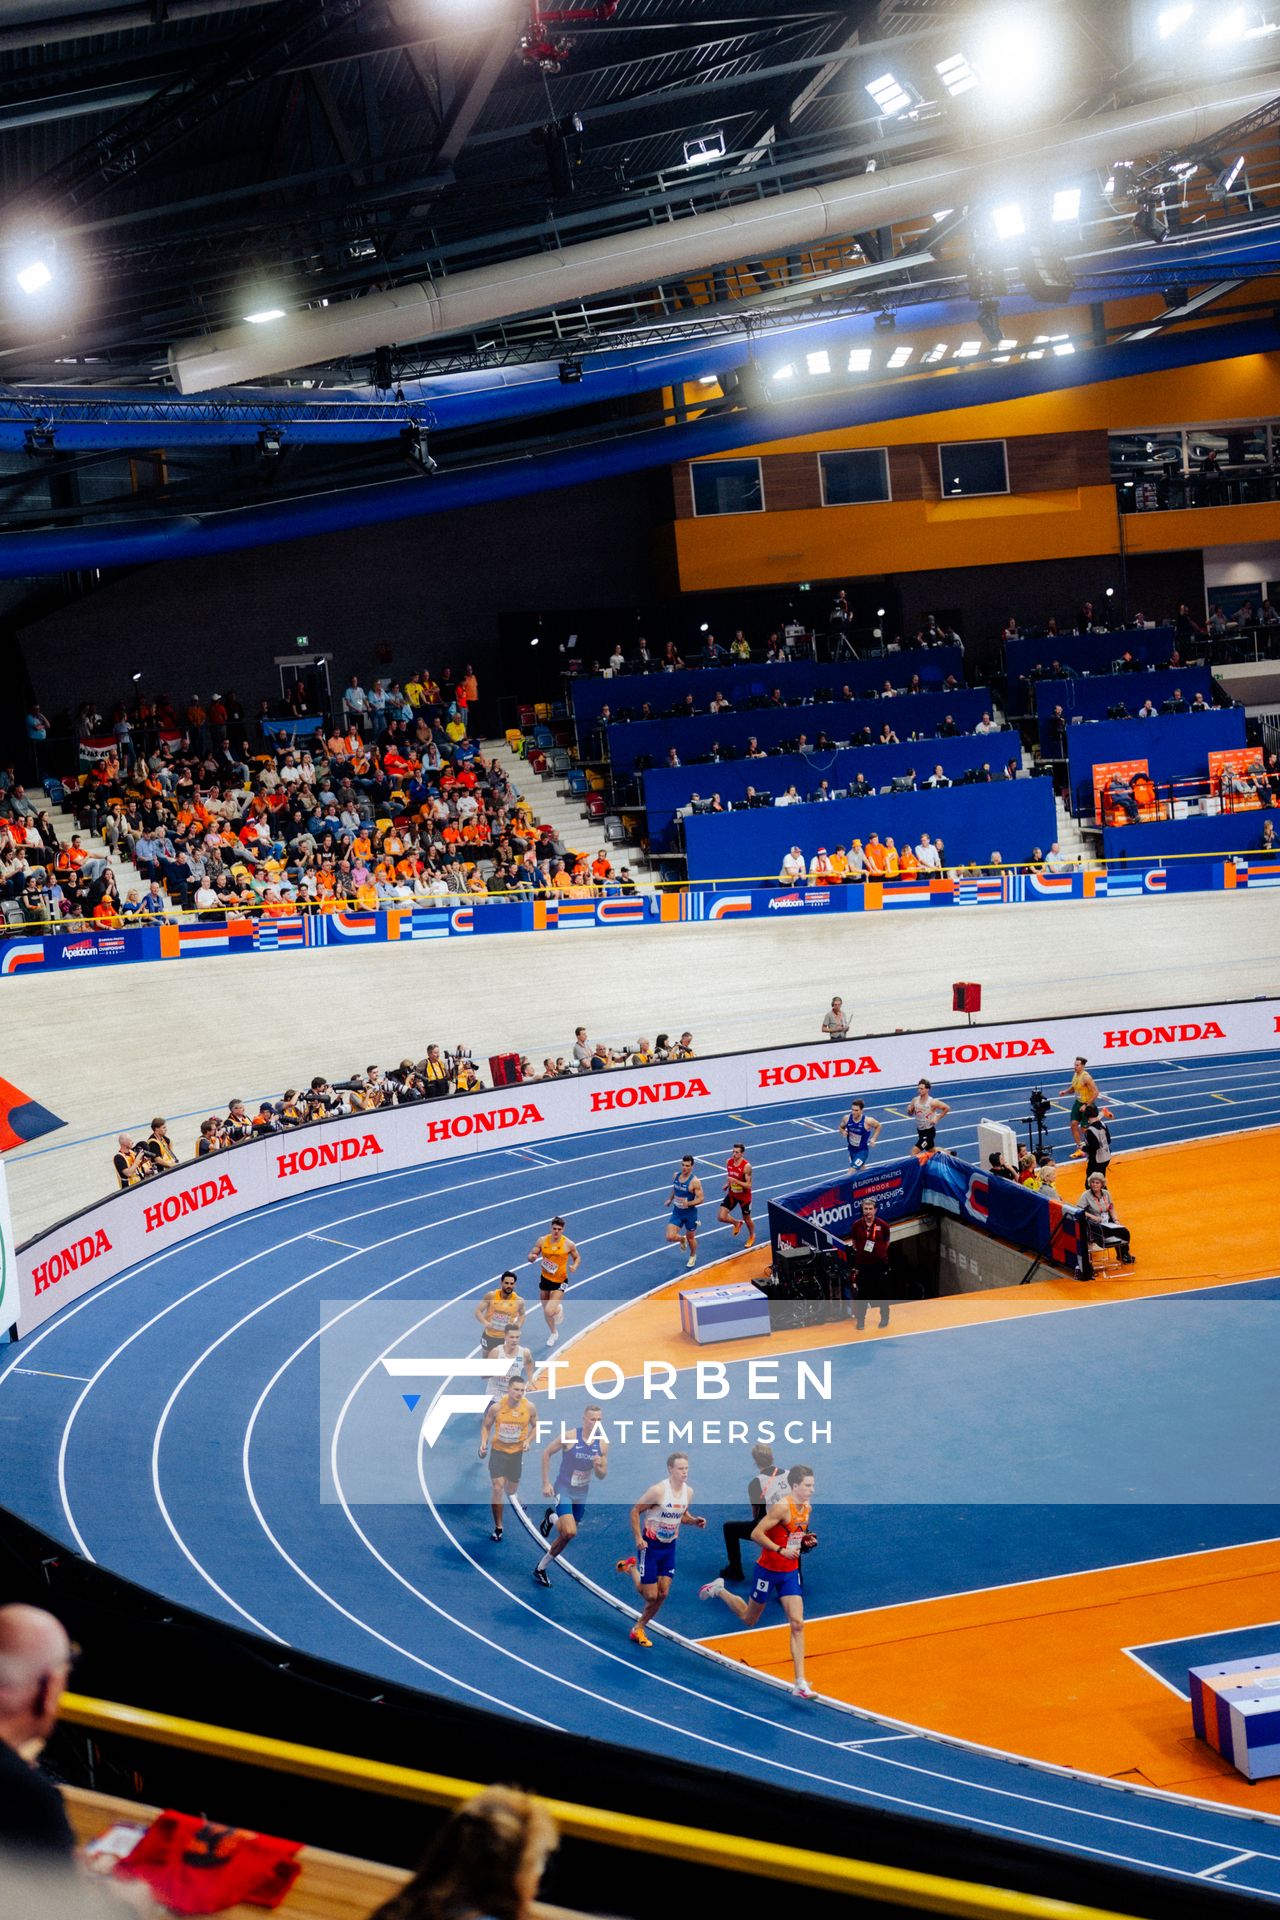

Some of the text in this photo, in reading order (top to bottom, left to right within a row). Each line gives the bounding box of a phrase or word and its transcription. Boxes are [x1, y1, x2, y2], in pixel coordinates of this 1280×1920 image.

[62, 946, 98, 960] Apeldoorn
[1103, 1021, 1226, 1049] HONDA
[929, 1038, 1055, 1067] HONDA
[758, 1056, 881, 1088] HONDA
[591, 1078, 711, 1112] HONDA
[426, 1103, 545, 1143] HONDA
[276, 1134, 384, 1178] HONDA
[143, 1174, 238, 1233] HONDA
[865, 1182, 890, 1194] INDOOR
[31, 1228, 113, 1296] HONDA
[759, 1581, 766, 1590] 9
